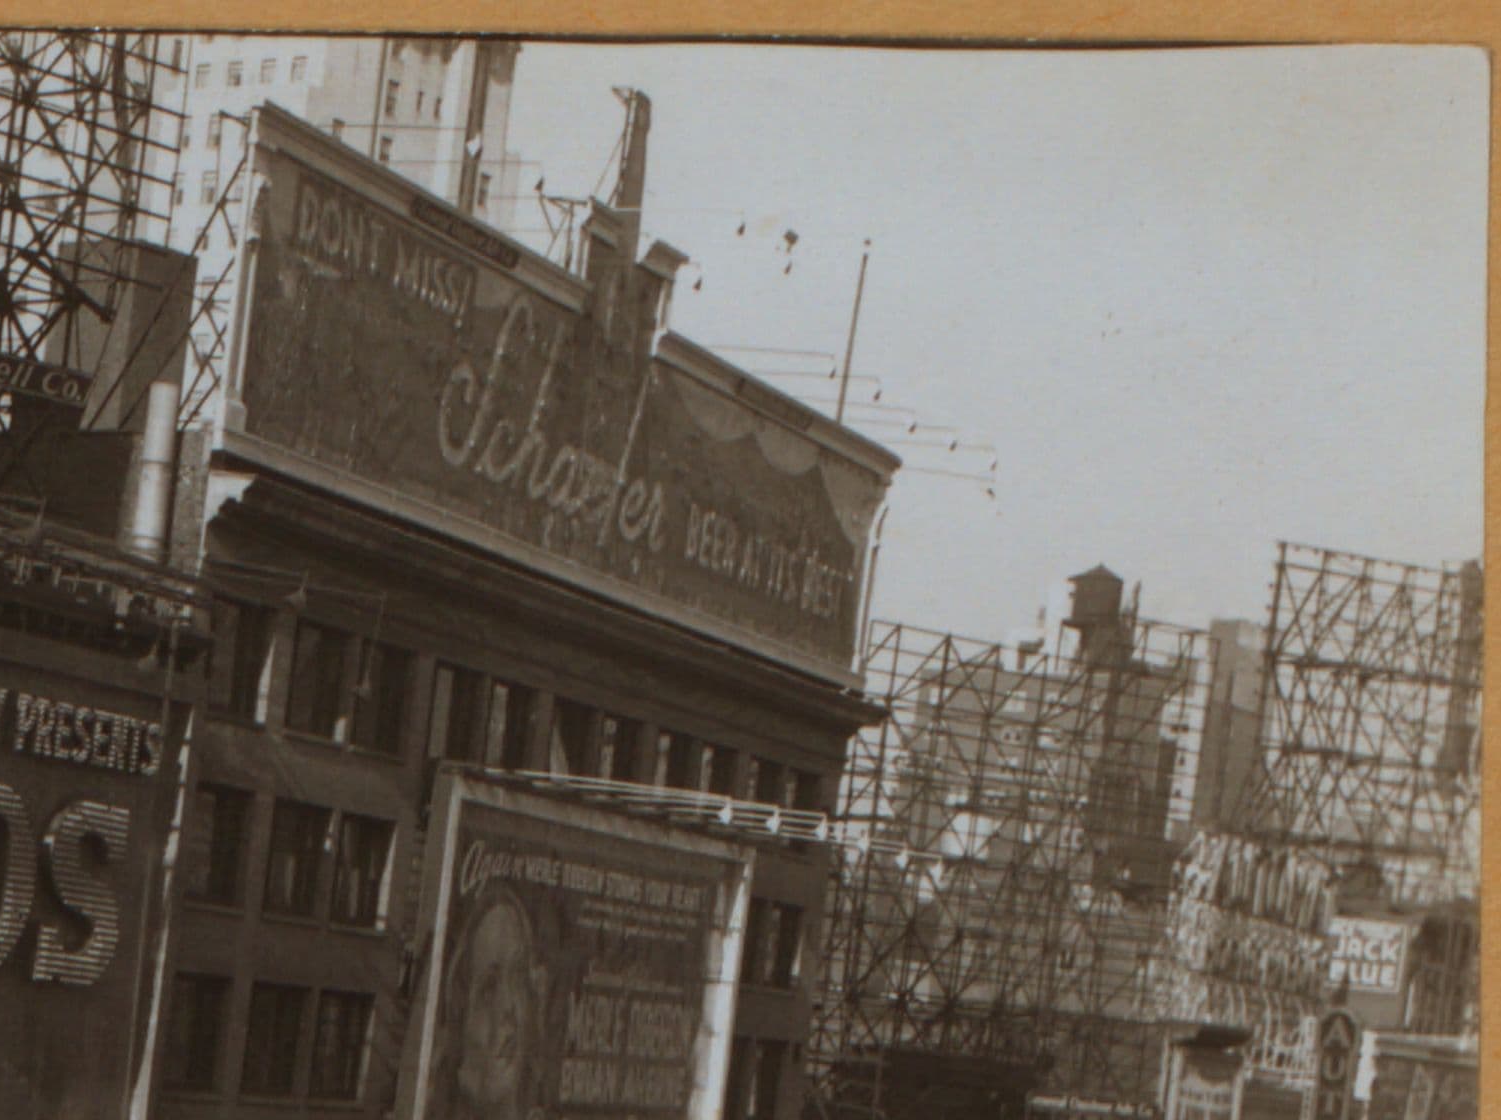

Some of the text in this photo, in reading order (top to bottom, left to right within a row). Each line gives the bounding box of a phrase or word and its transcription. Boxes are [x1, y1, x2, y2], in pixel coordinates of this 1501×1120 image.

[41, 371, 82, 402] Co.
[13, 692, 163, 777] PRESENTS
[1331, 934, 1401, 962] JACK
